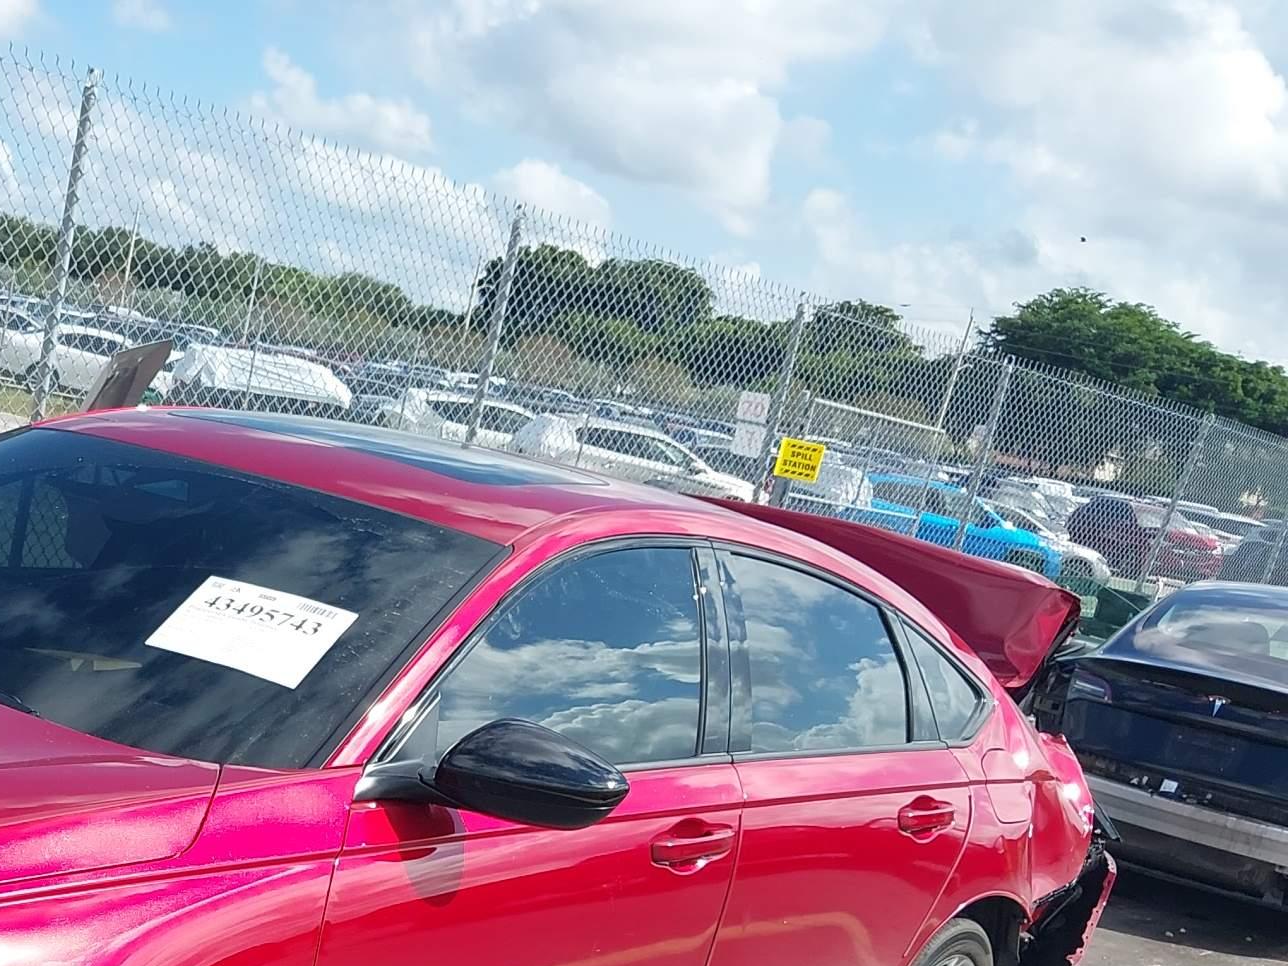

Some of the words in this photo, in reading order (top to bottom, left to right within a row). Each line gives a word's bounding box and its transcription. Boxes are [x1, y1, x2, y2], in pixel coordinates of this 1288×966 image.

[791, 450, 813, 461] SPILL
[782, 459, 817, 472] STATION
[203, 595, 323, 636] 43495743
